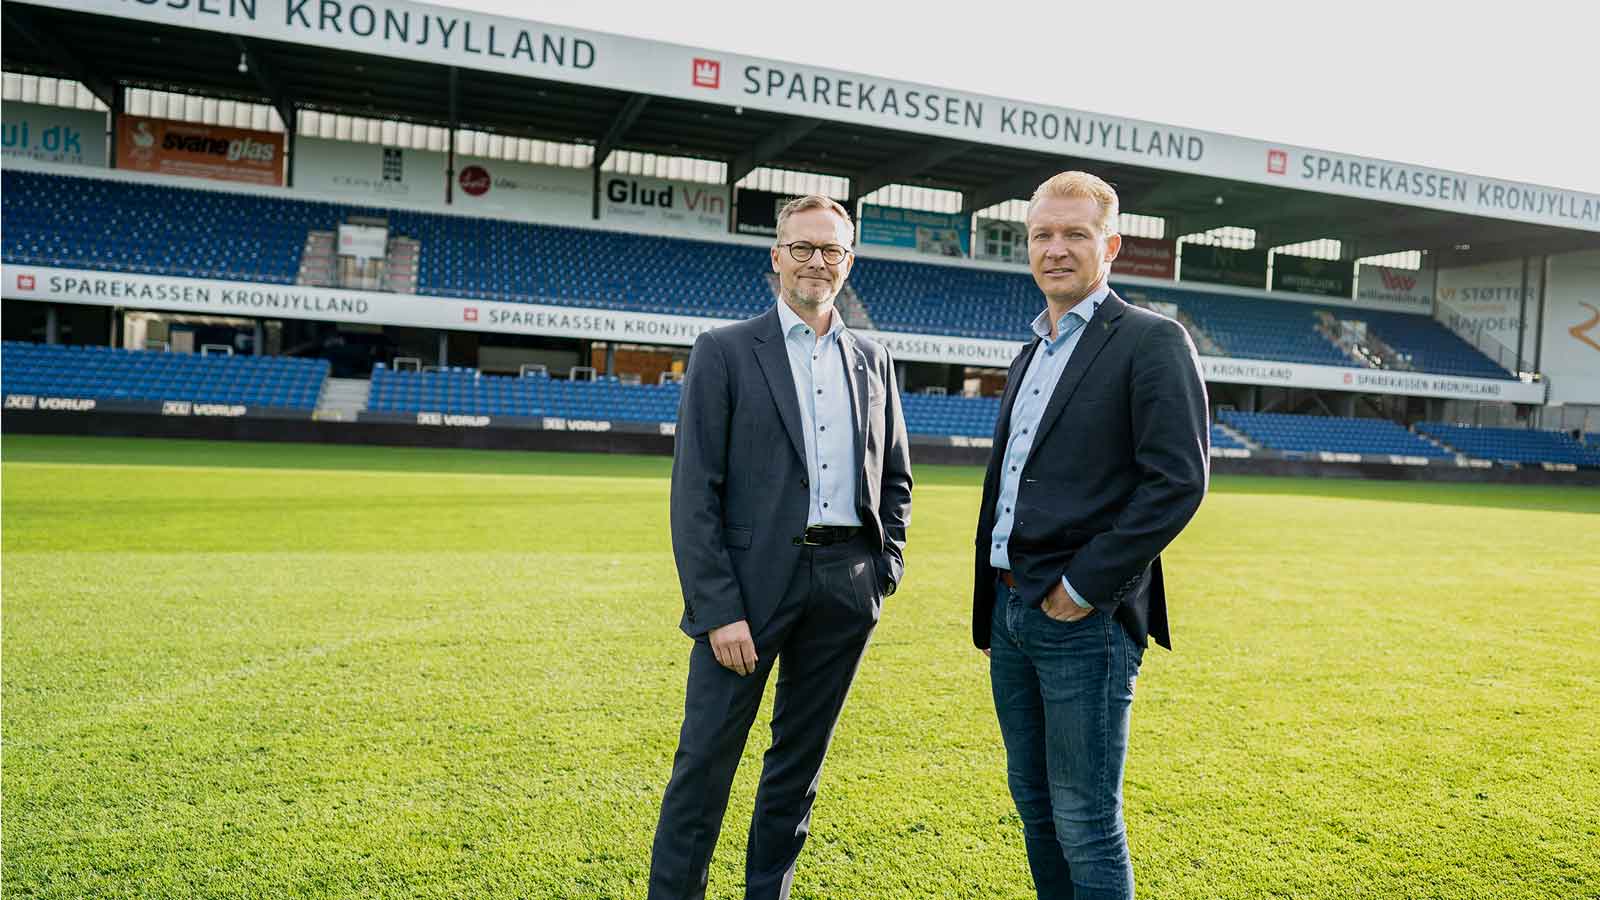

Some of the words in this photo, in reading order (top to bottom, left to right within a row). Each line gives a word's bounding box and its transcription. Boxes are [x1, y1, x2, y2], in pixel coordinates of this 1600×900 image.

[286, 0, 594, 69] KRONJYLLAND
[743, 65, 983, 128] SPAREKASSEN
[1000, 106, 1204, 161] KRONJYLLAND
[607, 178, 673, 208] Glud
[683, 187, 725, 214] Vin
[1301, 154, 1467, 203] SPAREKASSEN
[49, 275, 210, 303] SPAREKASSEN
[221, 289, 369, 314] KRONJYLLAND
[489, 310, 616, 331] SPAREKASSEN
[624, 319, 713, 338] KRONJYLL
